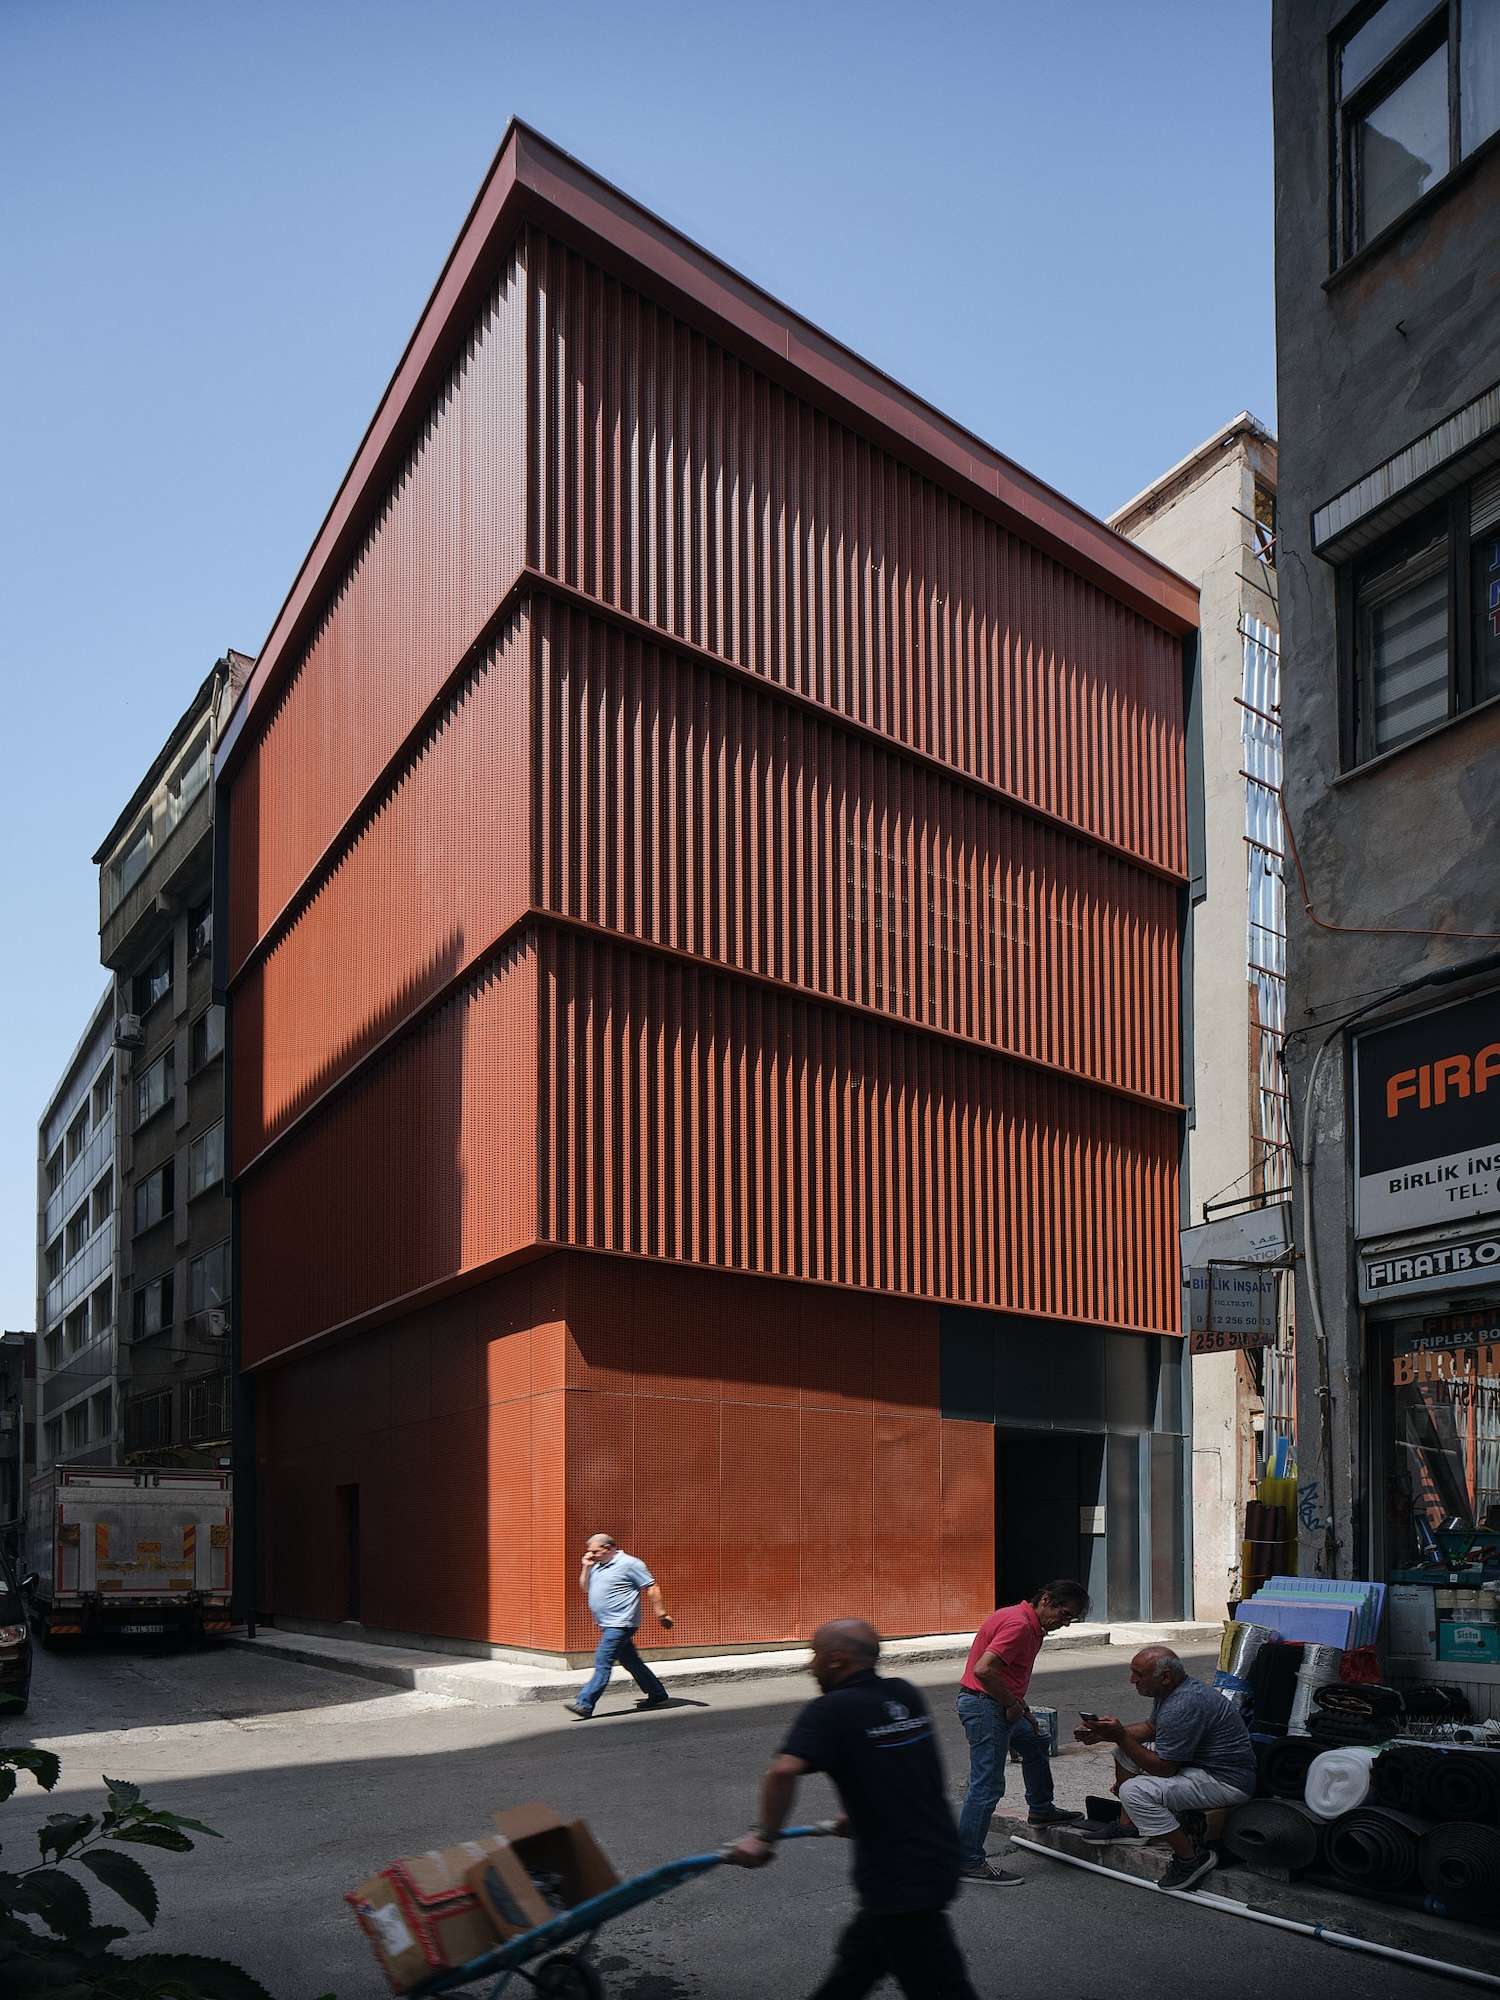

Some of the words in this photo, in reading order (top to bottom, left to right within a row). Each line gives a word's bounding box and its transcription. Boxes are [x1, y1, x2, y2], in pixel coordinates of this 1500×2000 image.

[1389, 1164, 1459, 1194] BİRLİK
[1445, 1183, 1488, 1202] TEL:
[1370, 1242, 1500, 1286] FIRATBO
[1233, 1278, 1272, 1295] İNŞAAT
[1196, 1332, 1224, 1351] 256
[1411, 1331, 1473, 1349] TRIPLEX
[1393, 1338, 1500, 1386] BİRLİ
